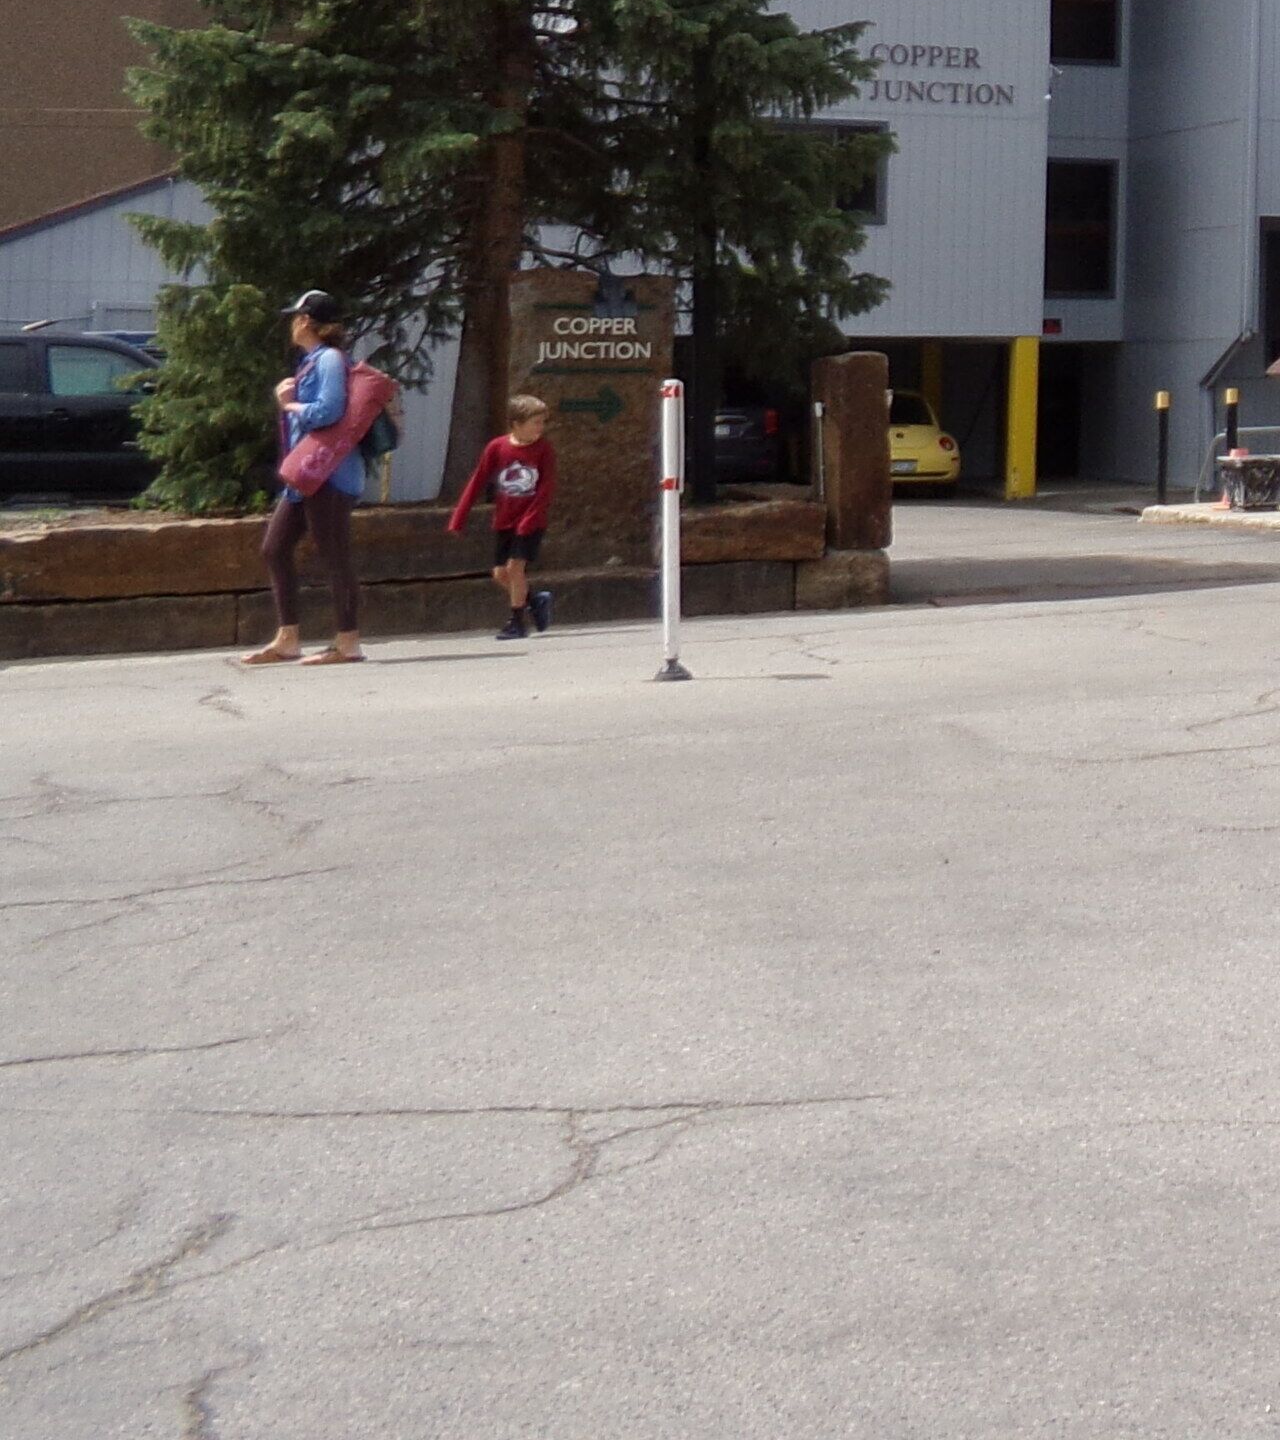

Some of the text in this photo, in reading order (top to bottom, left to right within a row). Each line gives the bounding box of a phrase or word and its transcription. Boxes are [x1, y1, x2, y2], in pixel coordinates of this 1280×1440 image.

[866, 80, 1014, 106] JUNCTION
[553, 317, 637, 335] COPPER
[536, 341, 652, 364] JUNCTION
